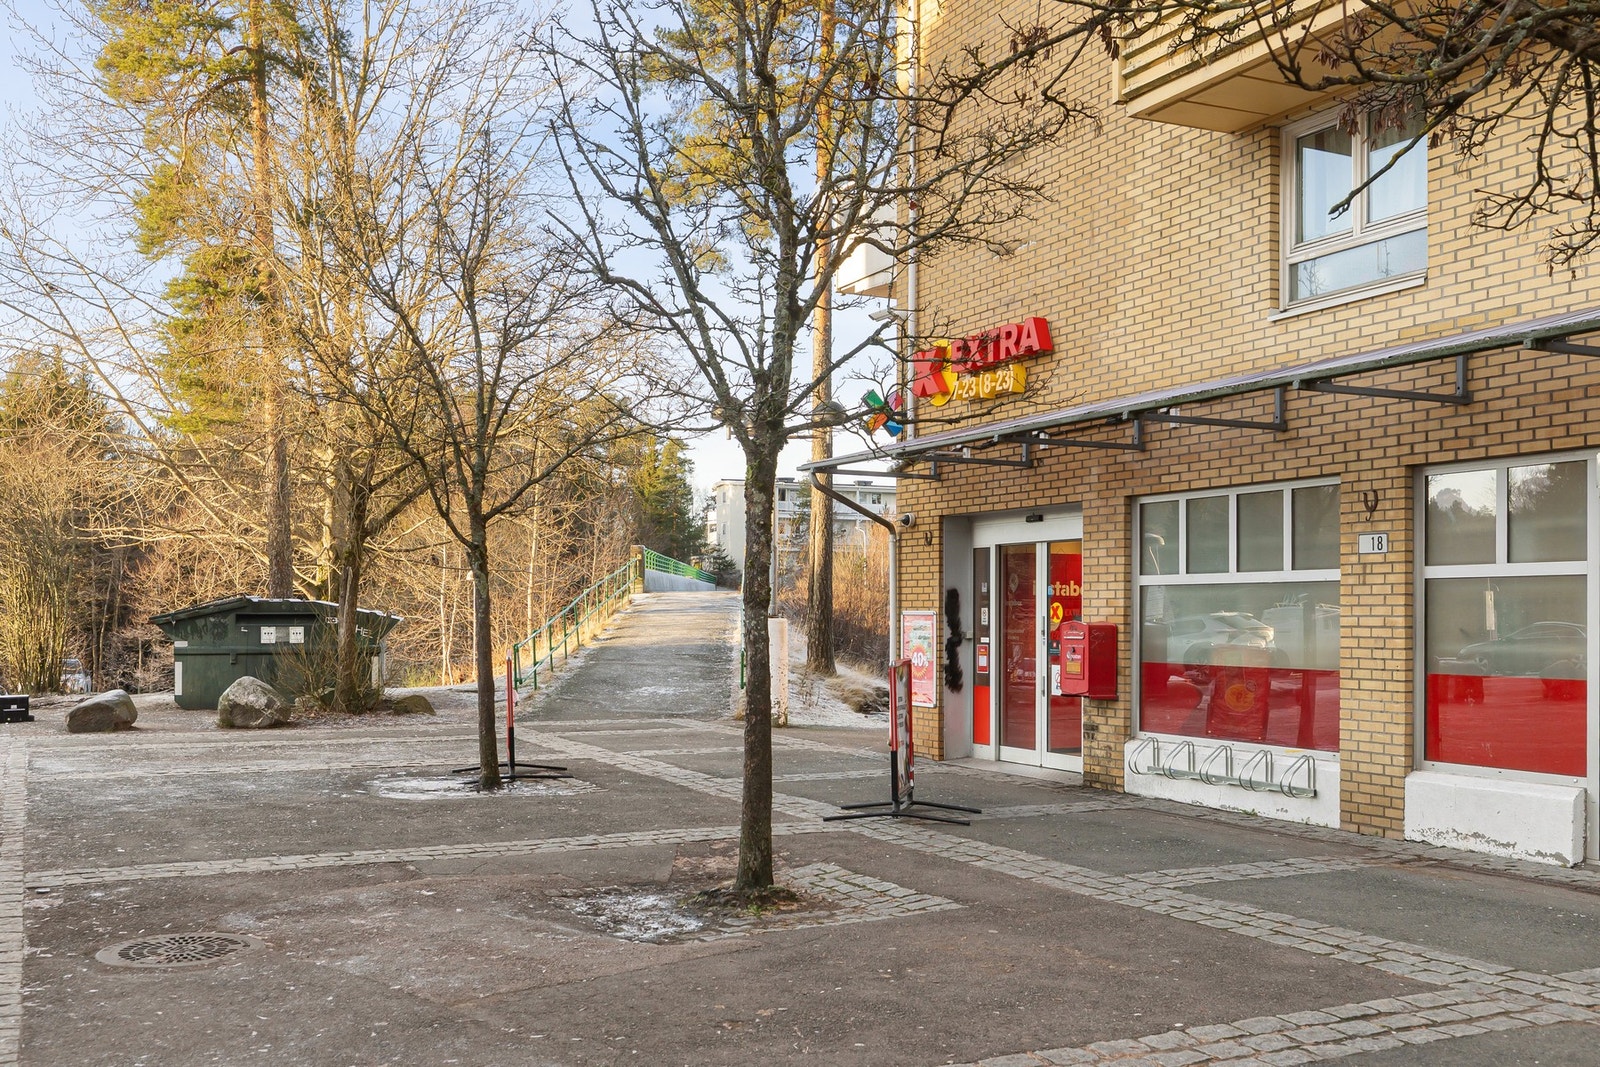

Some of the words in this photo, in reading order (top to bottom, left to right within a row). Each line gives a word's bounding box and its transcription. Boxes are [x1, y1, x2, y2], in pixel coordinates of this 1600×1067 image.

[911, 348, 942, 398] X
[950, 316, 1043, 373] EXTRA
[979, 363, 1014, 399] (8-23)
[1371, 535, 1383, 551] 18
[912, 651, 929, 668] 40%
